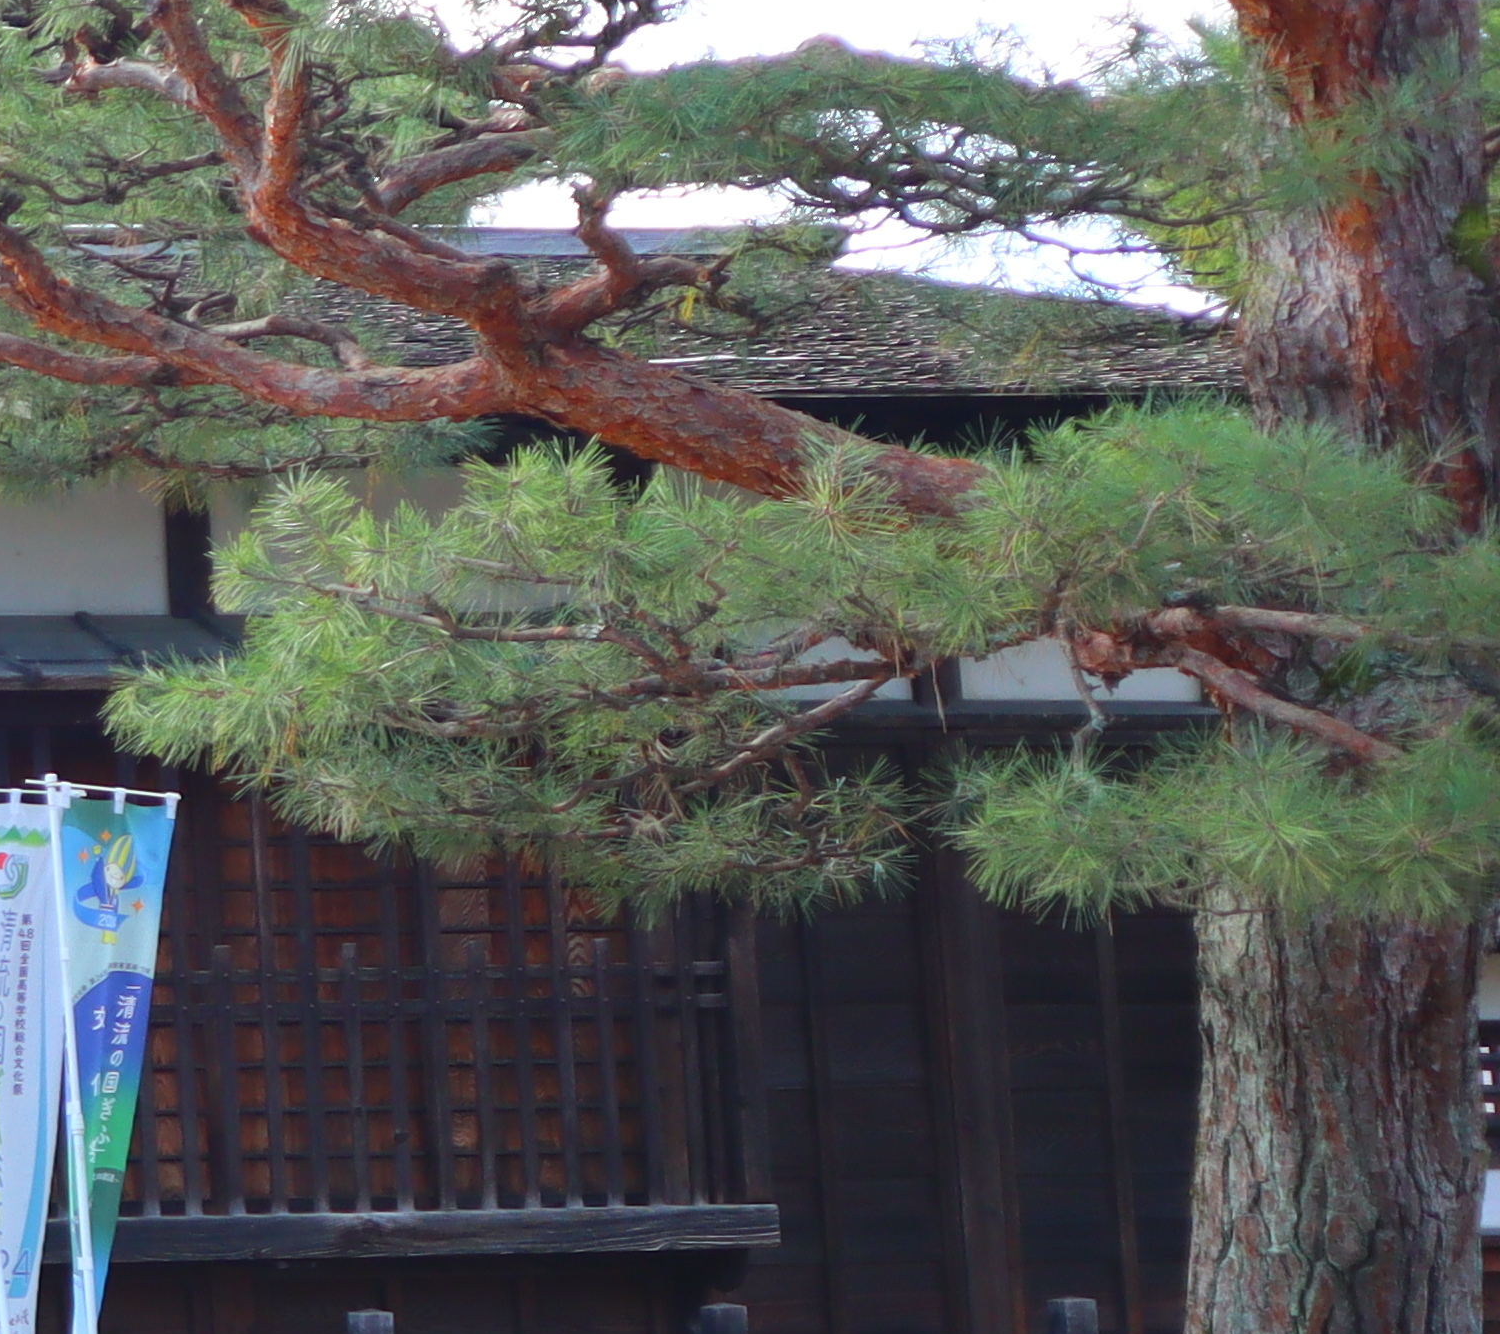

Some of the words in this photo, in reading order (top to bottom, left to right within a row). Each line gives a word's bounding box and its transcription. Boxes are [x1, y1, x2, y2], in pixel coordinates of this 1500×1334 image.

[13, 913, 34, 1096] 第48回全国高等学校総合文化祭
